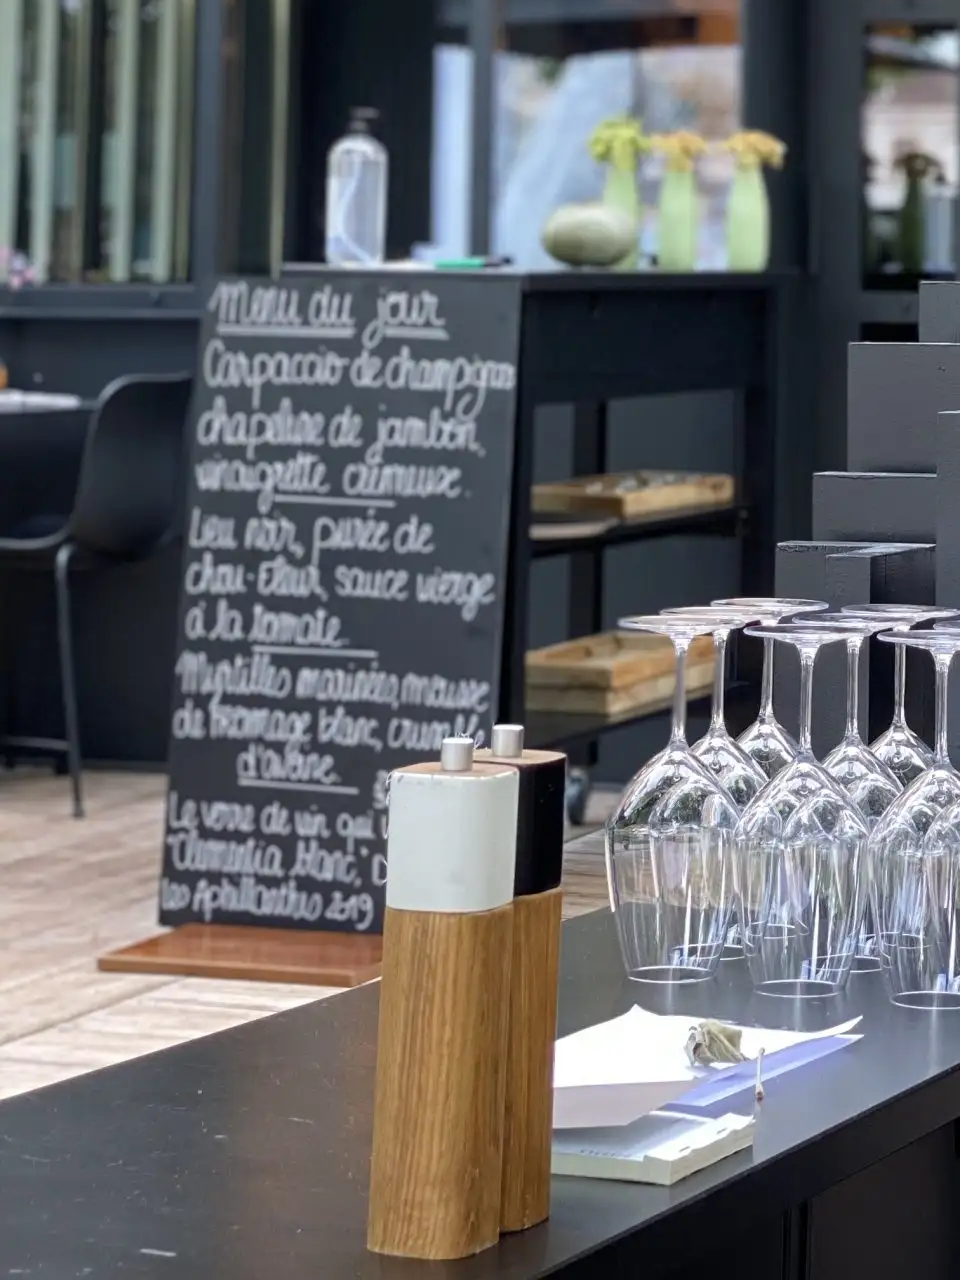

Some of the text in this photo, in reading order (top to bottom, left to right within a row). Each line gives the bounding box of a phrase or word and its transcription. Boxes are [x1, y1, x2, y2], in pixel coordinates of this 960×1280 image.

[309, 285, 355, 326] du
[362, 287, 445, 348] jour
[350, 349, 384, 388] de
[329, 405, 363, 448] de
[393, 514, 434, 553] de
[334, 564, 409, 601] sauce
[172, 699, 206, 740] de
[260, 801, 291, 835] de
[294, 805, 331, 839] vin
[325, 890, 376, 931] 2019
